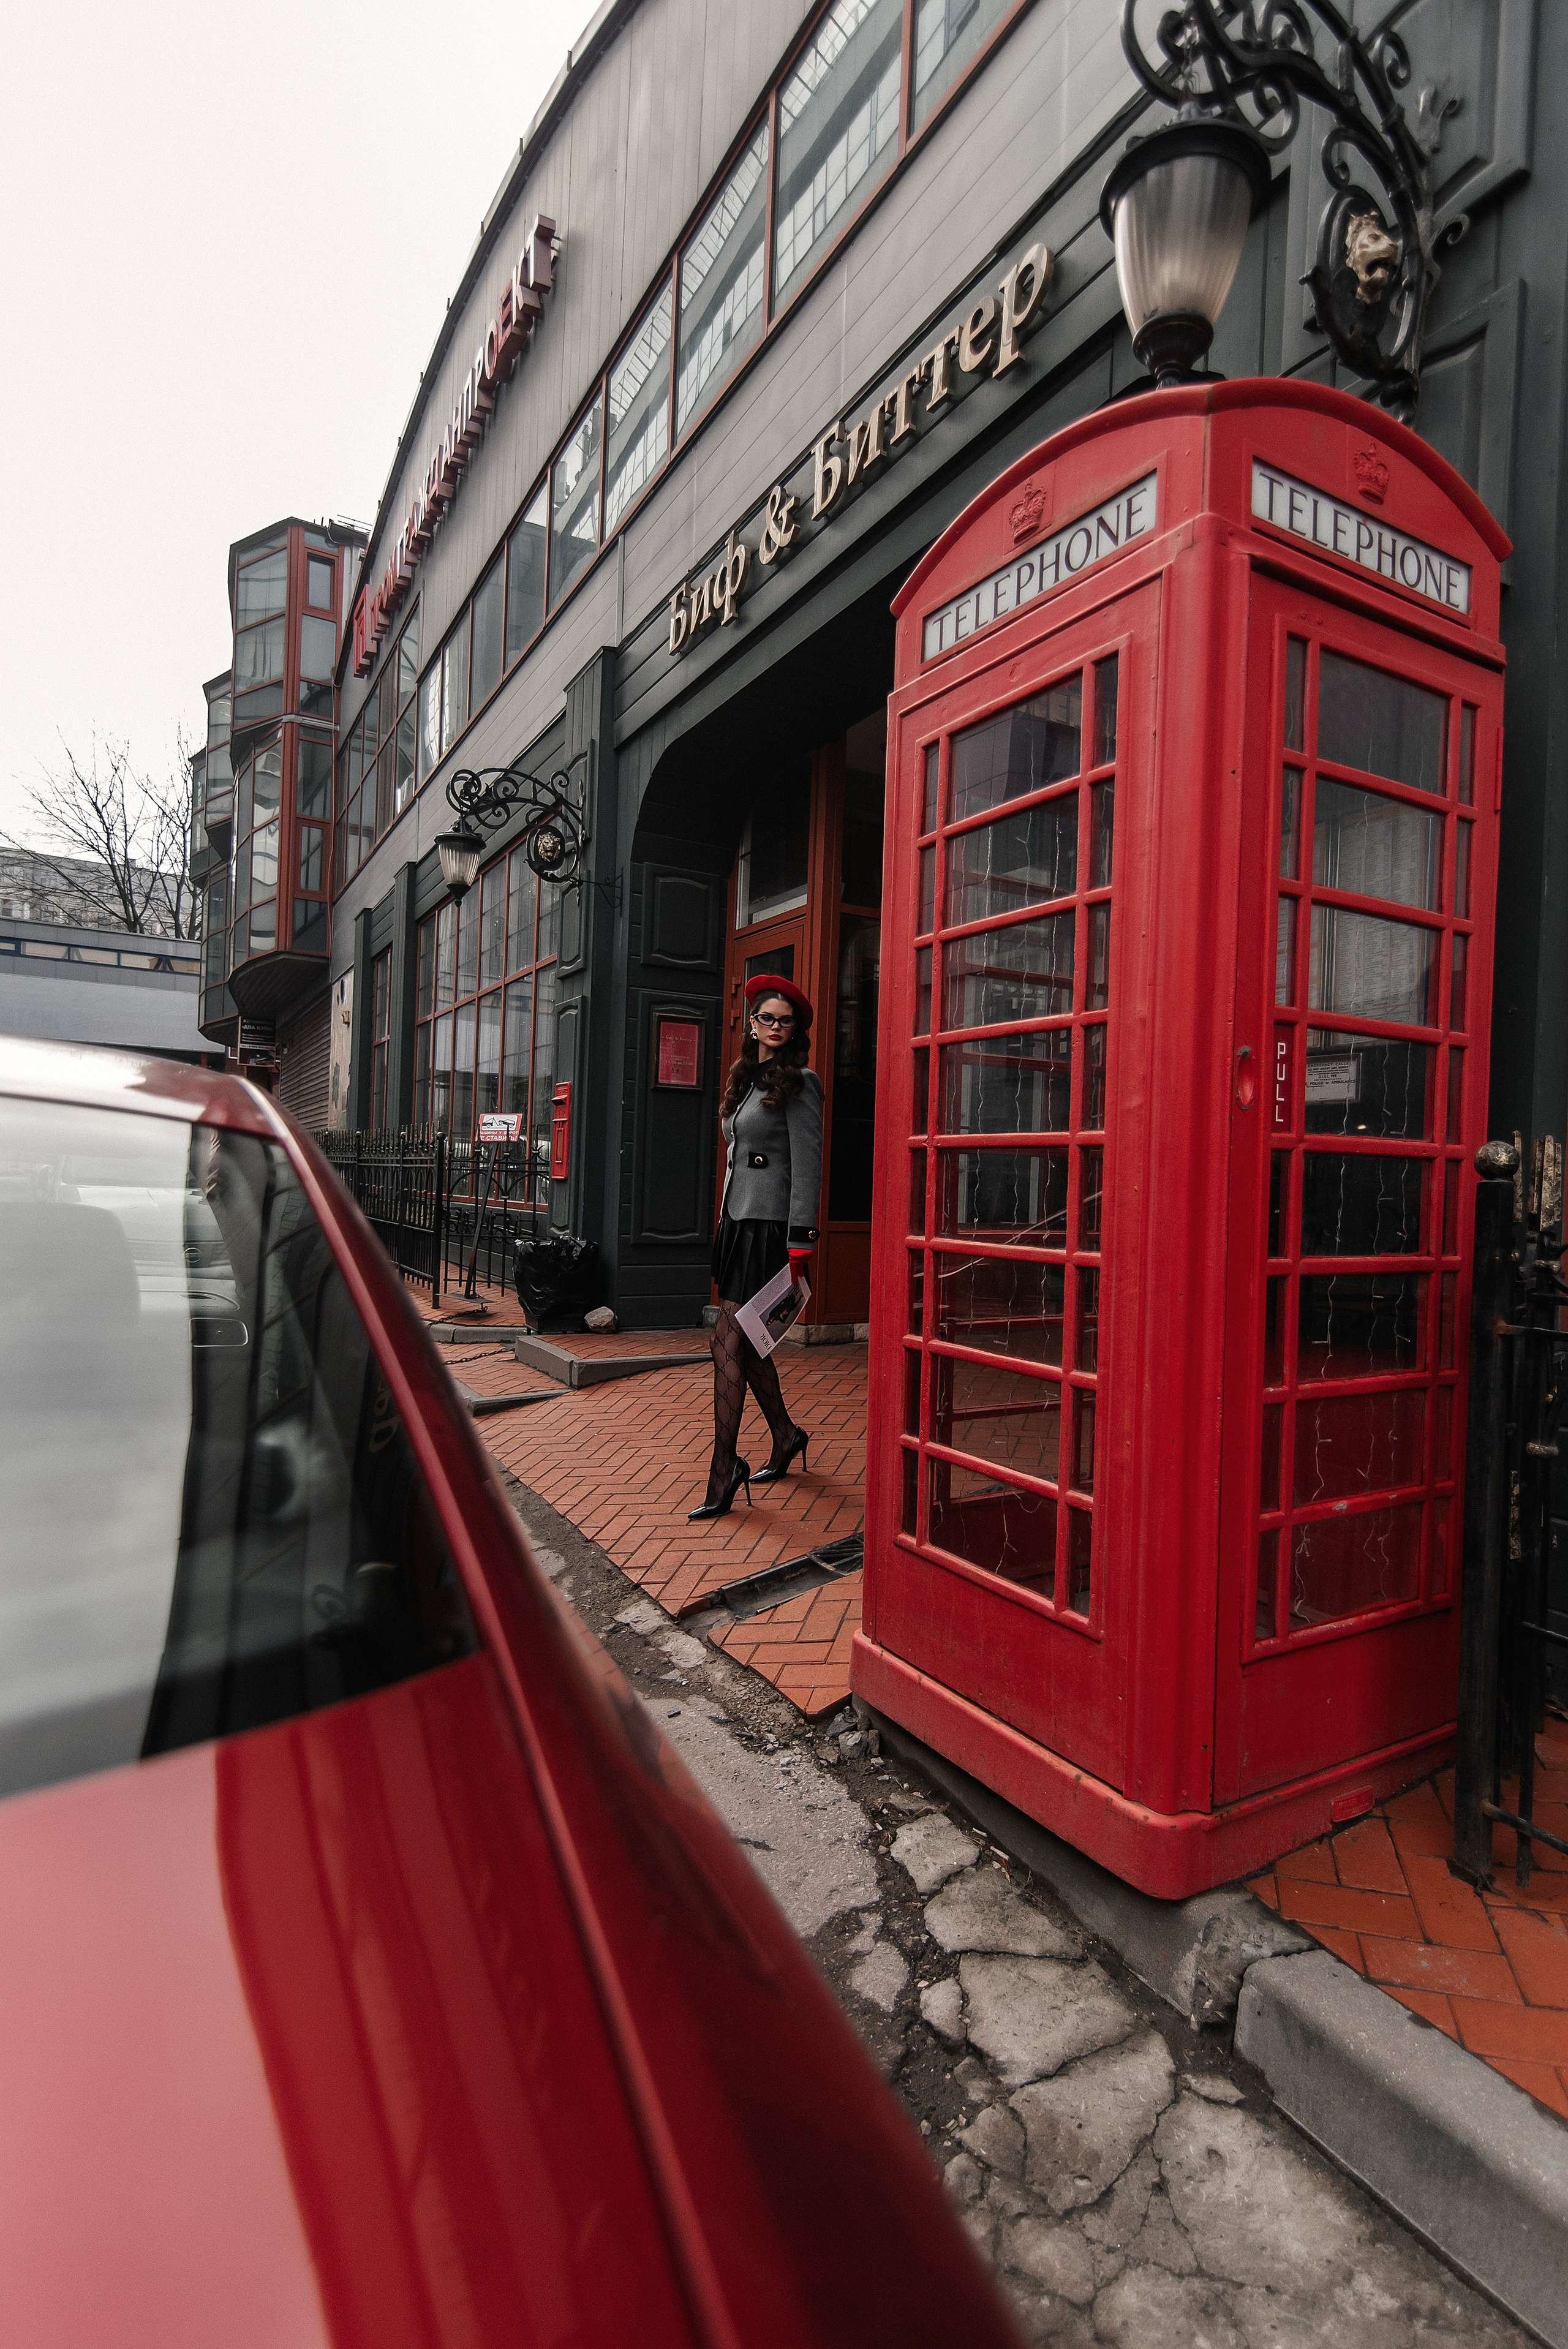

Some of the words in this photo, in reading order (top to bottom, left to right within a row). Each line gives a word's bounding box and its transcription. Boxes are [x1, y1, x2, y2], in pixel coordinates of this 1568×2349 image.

[667, 529, 751, 657] Биф
[758, 484, 801, 566] &
[810, 243, 1055, 522] Биттер
[932, 487, 1147, 652] TELEPHONE
[1258, 471, 1461, 609] TELEPHONE
[1276, 1042, 1286, 1123] PULL
[760, 1333, 772, 1351] DIOR
